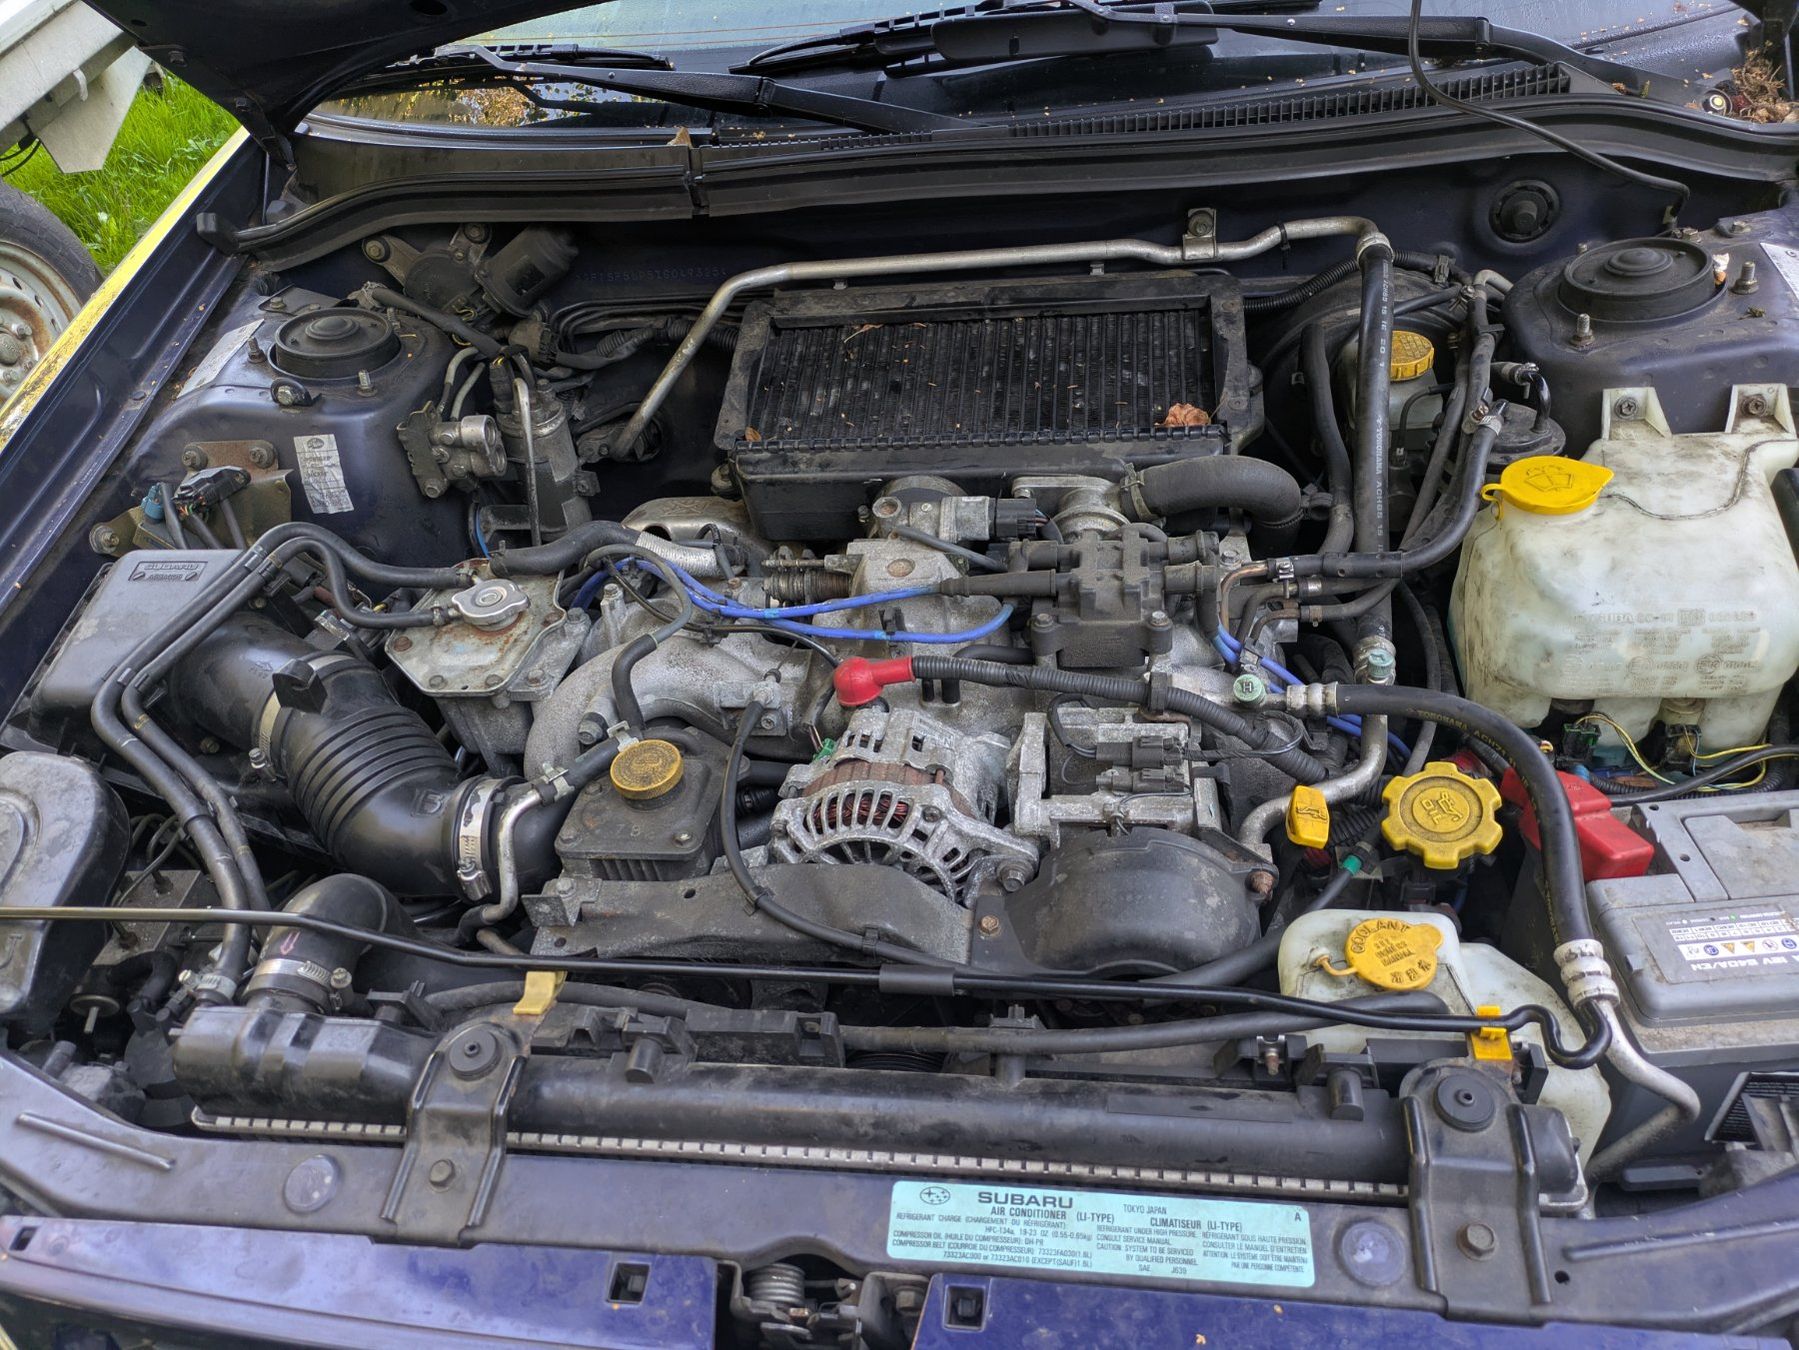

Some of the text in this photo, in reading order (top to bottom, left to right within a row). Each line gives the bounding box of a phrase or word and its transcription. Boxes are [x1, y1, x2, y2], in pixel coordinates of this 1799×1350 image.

[1242, 681, 1254, 693] H
[1421, 799, 1442, 825] OIL
[1351, 920, 1411, 954] COOLANT
[978, 1191, 1073, 1209] SUBARU
[991, 1206, 1006, 1216] AIR
[1009, 1207, 1067, 1220] CONDITIONER
[1123, 1204, 1167, 1215] TOKYO JAPAN
[938, 1214, 961, 1223] CHARGE
[1294, 1211, 1302, 1221] A
[1150, 1217, 1202, 1230] CLIMATISEUR
[893, 1230, 932, 1239] COMPRESSOR
[1096, 1233, 1122, 1242] CONSULT
[1123, 1235, 1146, 1243] SERVICE
[892, 1239, 932, 1248] COMPRESSOR
[1202, 1240, 1235, 1250] CONSULTER
[1124, 1244, 1148, 1253] SYSTEM
[1167, 1247, 1194, 1256] SERVICED
[1135, 1254, 1164, 1263] QUALIFIED
